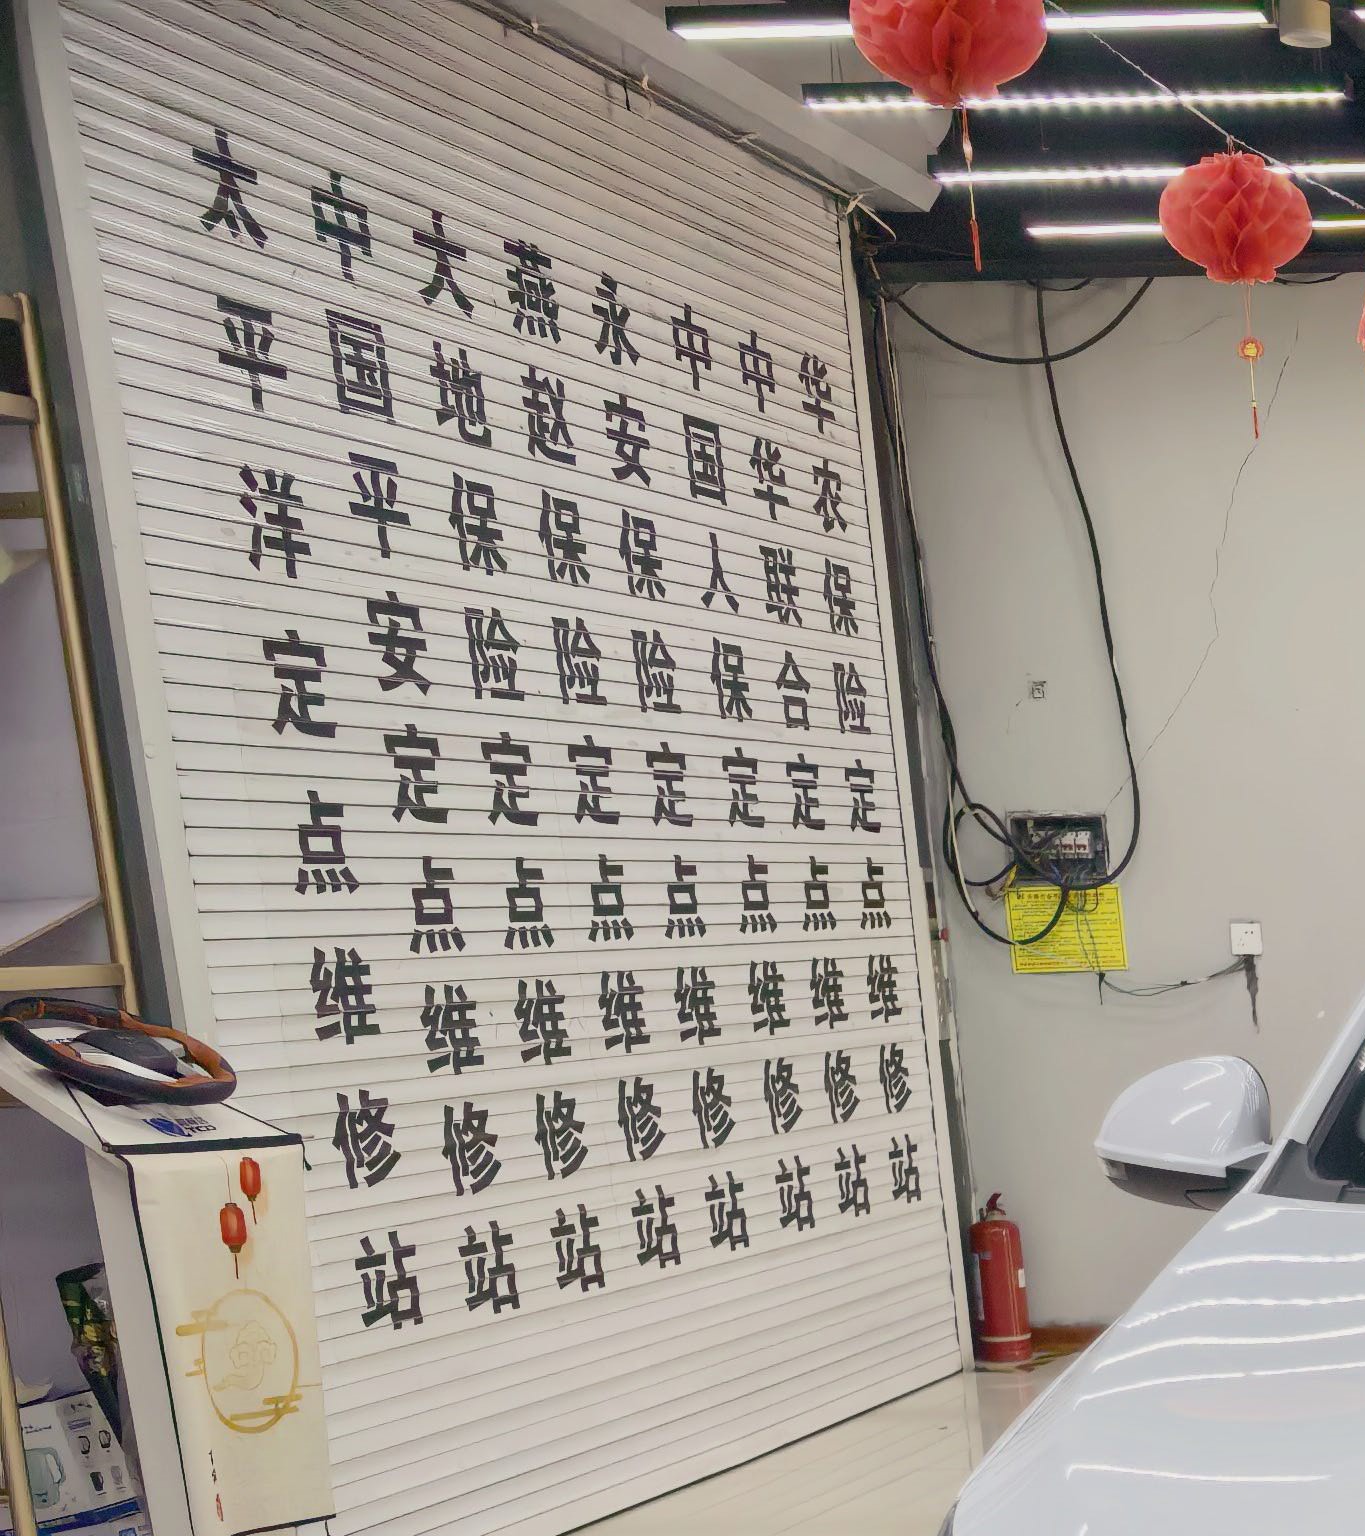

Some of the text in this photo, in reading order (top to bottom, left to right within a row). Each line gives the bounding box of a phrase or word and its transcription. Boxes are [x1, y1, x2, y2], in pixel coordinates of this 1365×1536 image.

[193, 129, 423, 1330] 太平洋定点维修站
[311, 172, 521, 1314] 中国平安定点维修站
[412, 210, 606, 1292] 大地保险定点维修站
[502, 239, 682, 1270] 燕赵保险定点维修站
[591, 271, 750, 1251] 永安保险定点维修站
[672, 303, 816, 1232] 中国人保定点维修站
[738, 330, 871, 1218] 中华联合定点维修站
[799, 350, 923, 1204] 华农保险定点维修站
